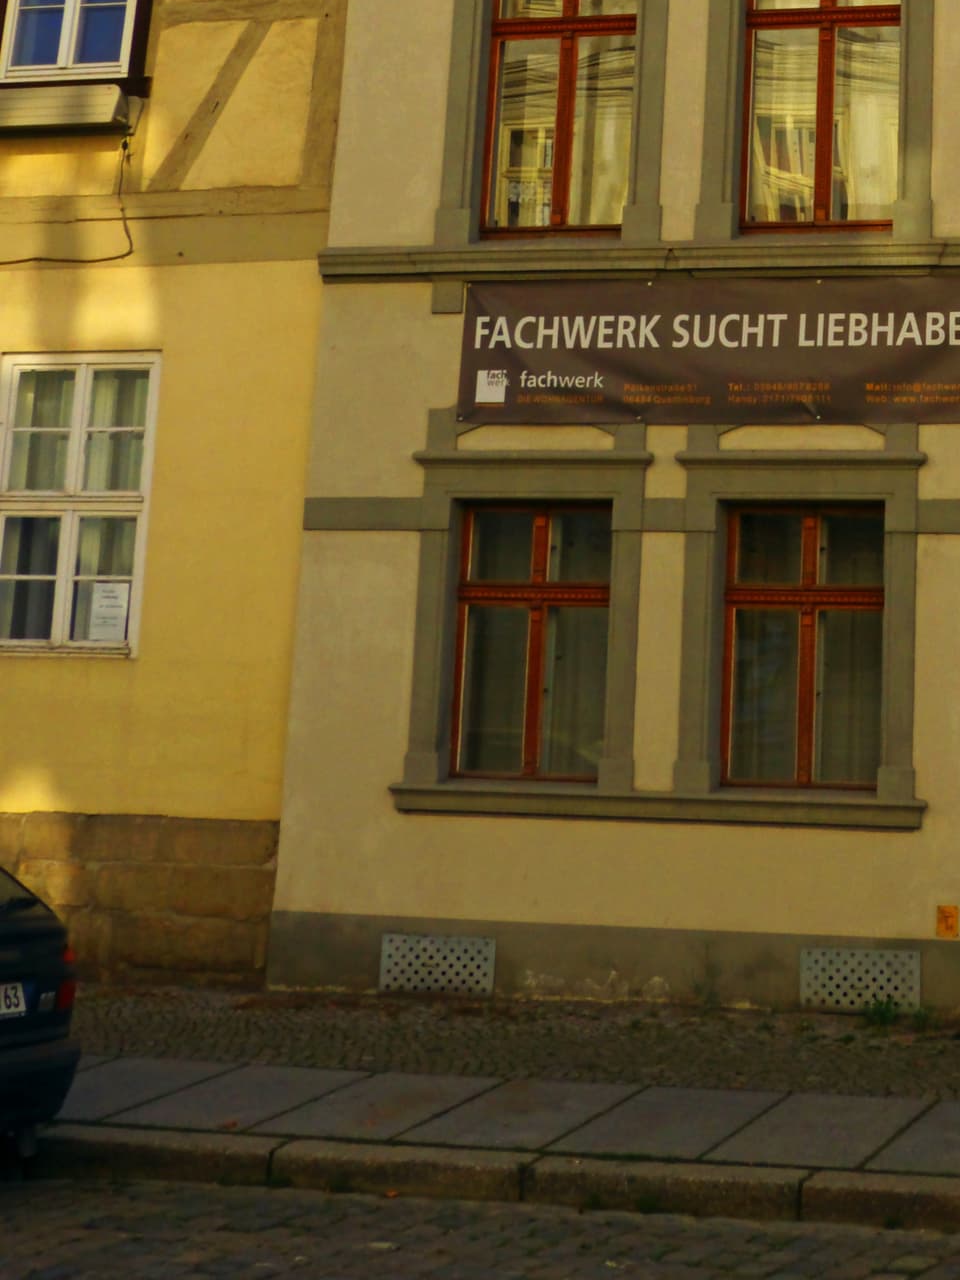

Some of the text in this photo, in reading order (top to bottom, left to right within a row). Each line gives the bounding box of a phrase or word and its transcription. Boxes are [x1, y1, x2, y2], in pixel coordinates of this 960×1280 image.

[474, 314, 662, 350] FACHWERK
[672, 313, 788, 349] SUCHT
[519, 369, 604, 389] fachwerk
